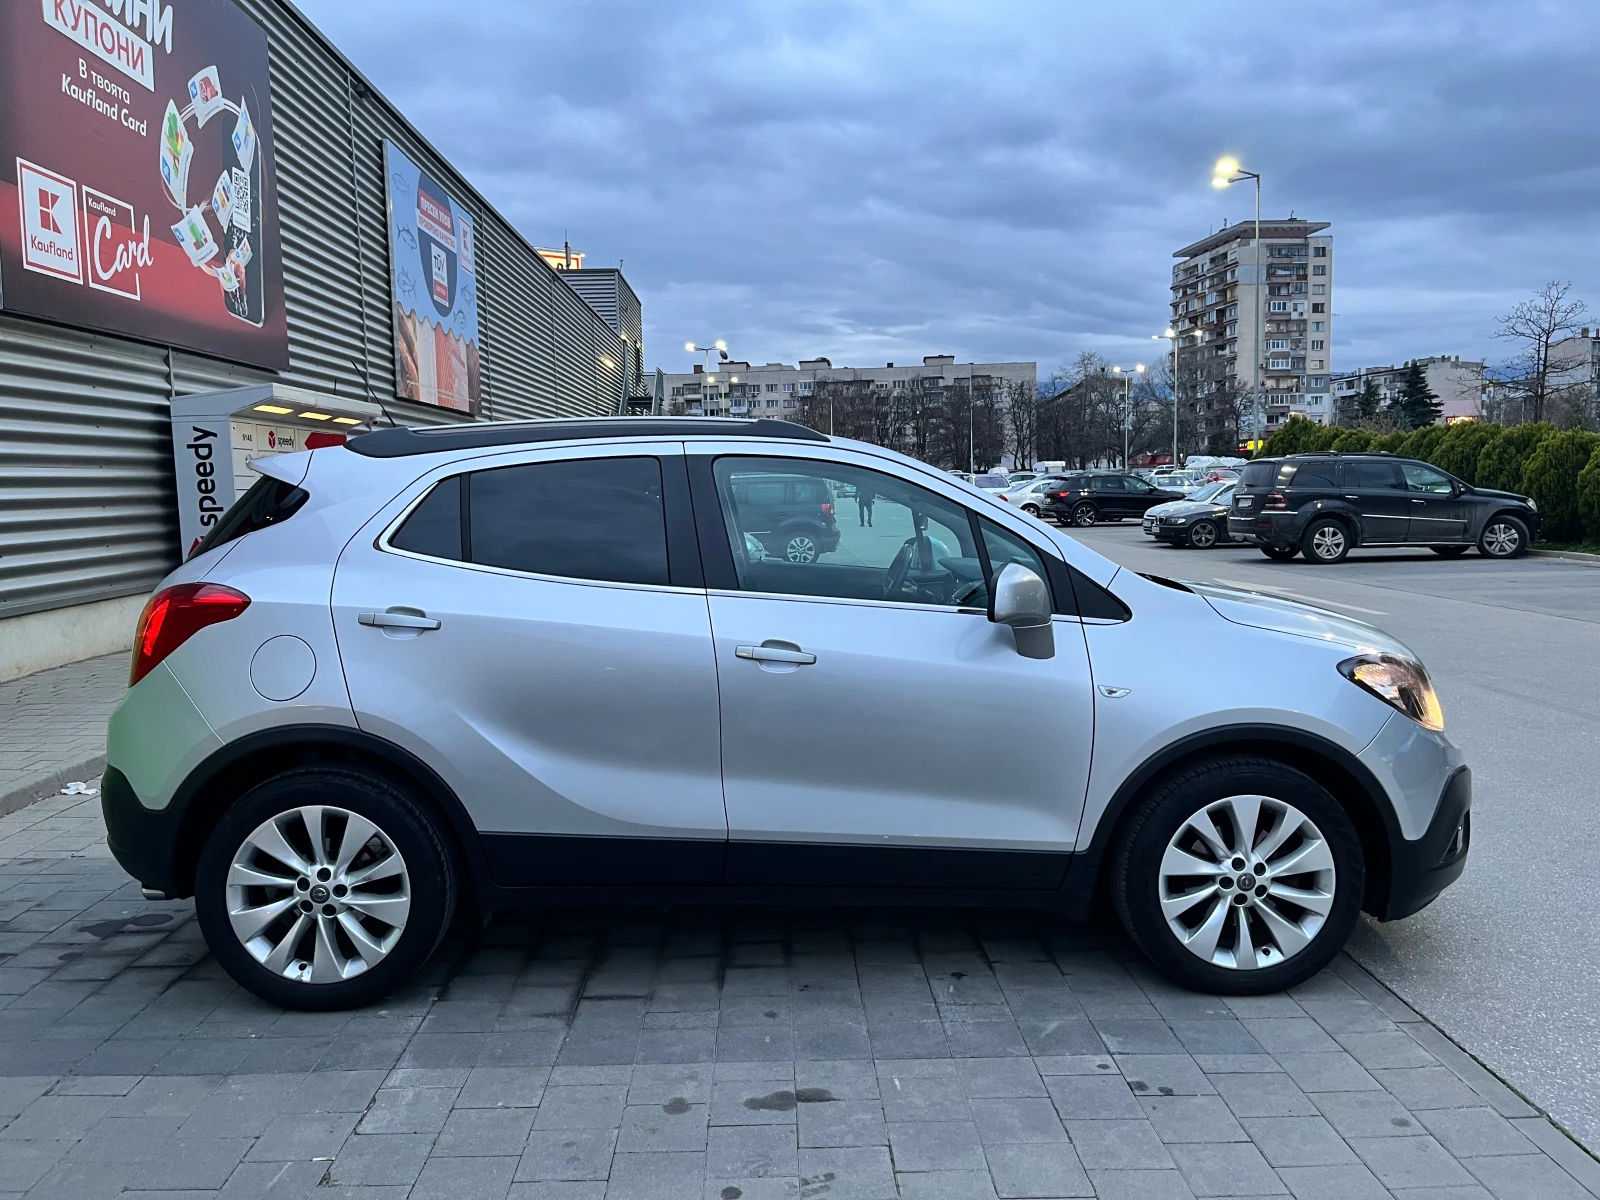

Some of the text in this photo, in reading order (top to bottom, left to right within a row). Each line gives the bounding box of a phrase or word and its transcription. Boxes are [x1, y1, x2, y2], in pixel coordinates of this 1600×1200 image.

[54, 0, 144, 76] КУПОНИ
[61, 73, 147, 137] Kaufland Card
[79, 57, 130, 105] В твоята
[87, 196, 117, 217] Kaufland
[30, 234, 74, 261] Kaufland
[93, 214, 154, 281] Card
[277, 435, 295, 448] speedy
[187, 426, 224, 527] speedy
